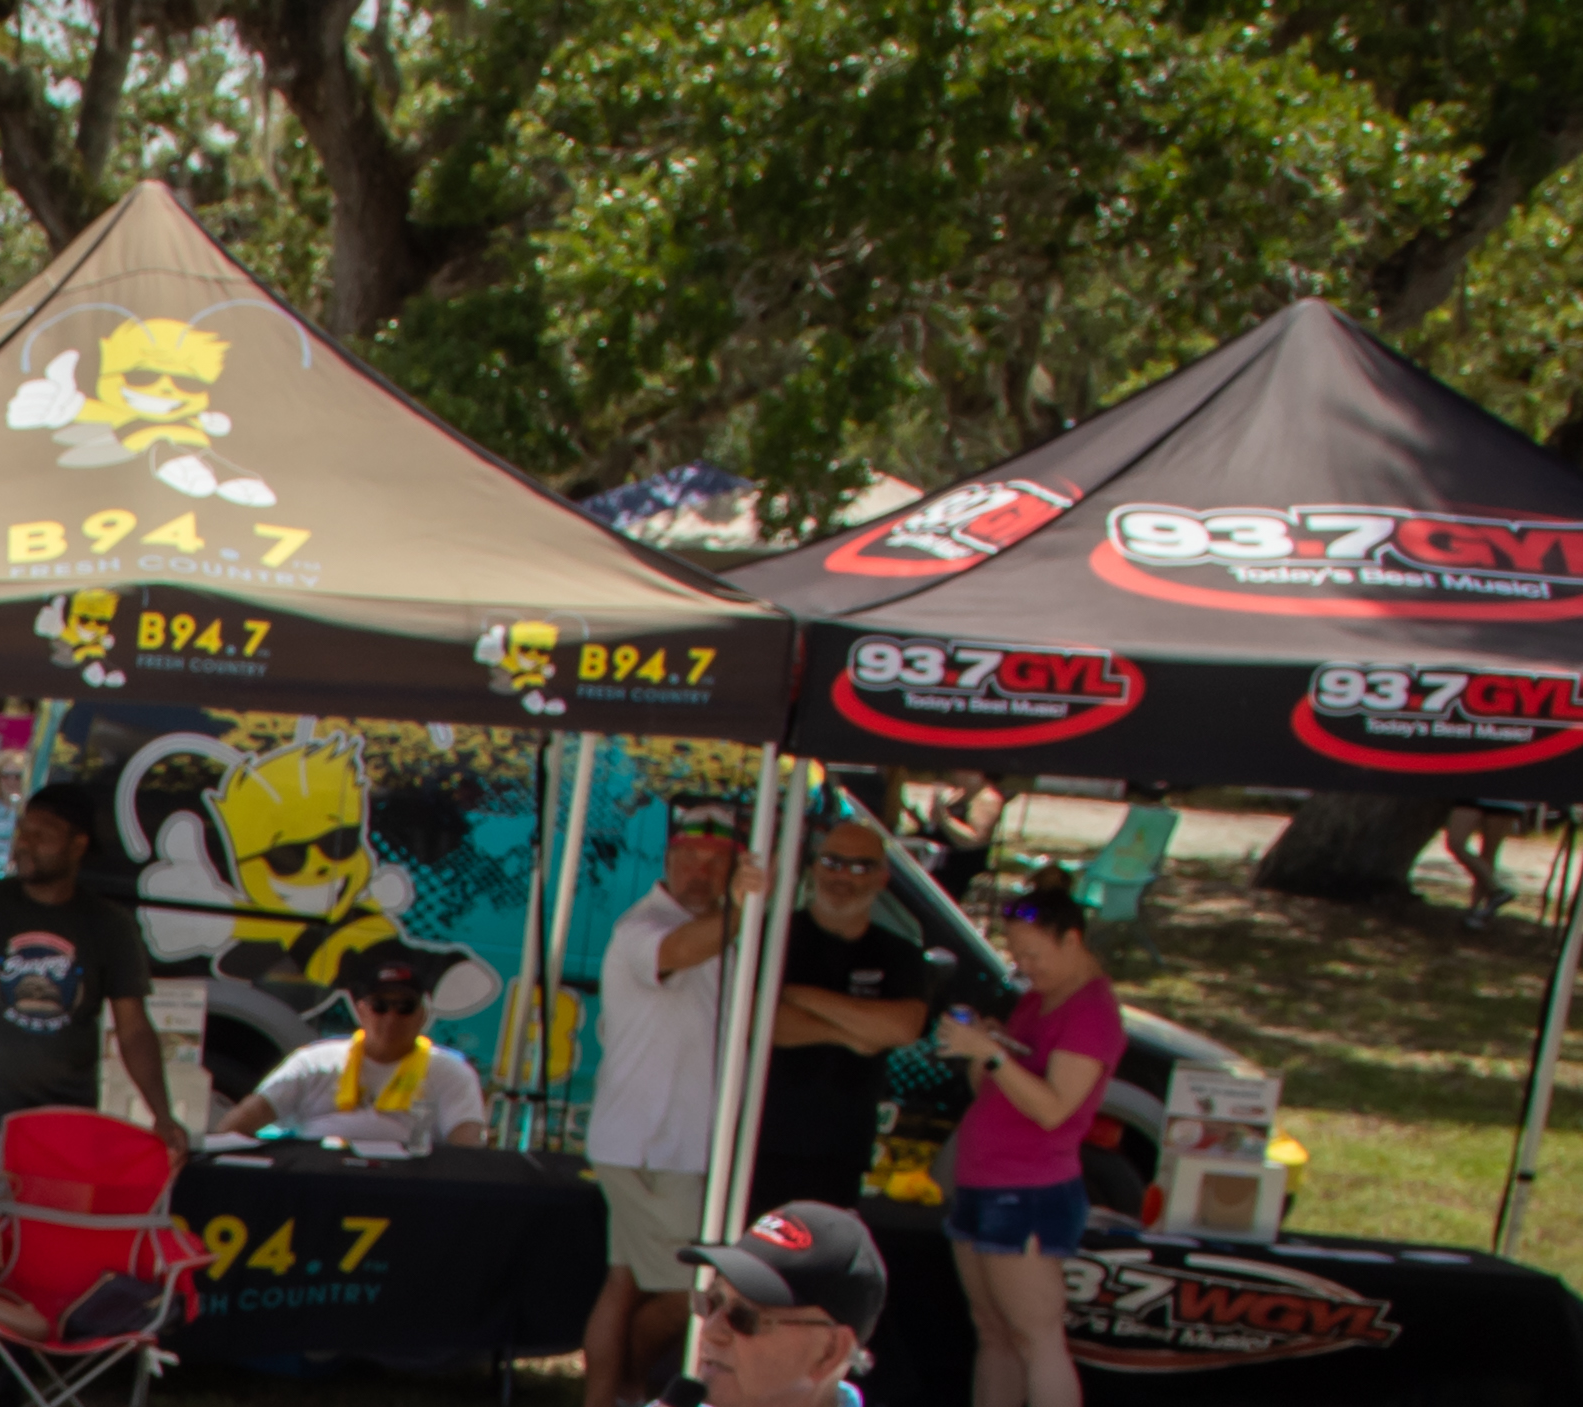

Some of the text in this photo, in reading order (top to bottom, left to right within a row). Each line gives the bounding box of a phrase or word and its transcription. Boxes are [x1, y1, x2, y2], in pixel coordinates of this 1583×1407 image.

[7, 509, 311, 568] B94.7
[9, 555, 320, 588] FRESH COUNTRY
[1230, 565, 1551, 599] Today's Best Music!
[136, 611, 271, 657] B94.7
[136, 654, 268, 677] FRESH COUNTRY
[578, 643, 717, 685] B94.7
[172, 1214, 391, 1280] 94.7
[237, 1283, 381, 1311] COUNTRY
